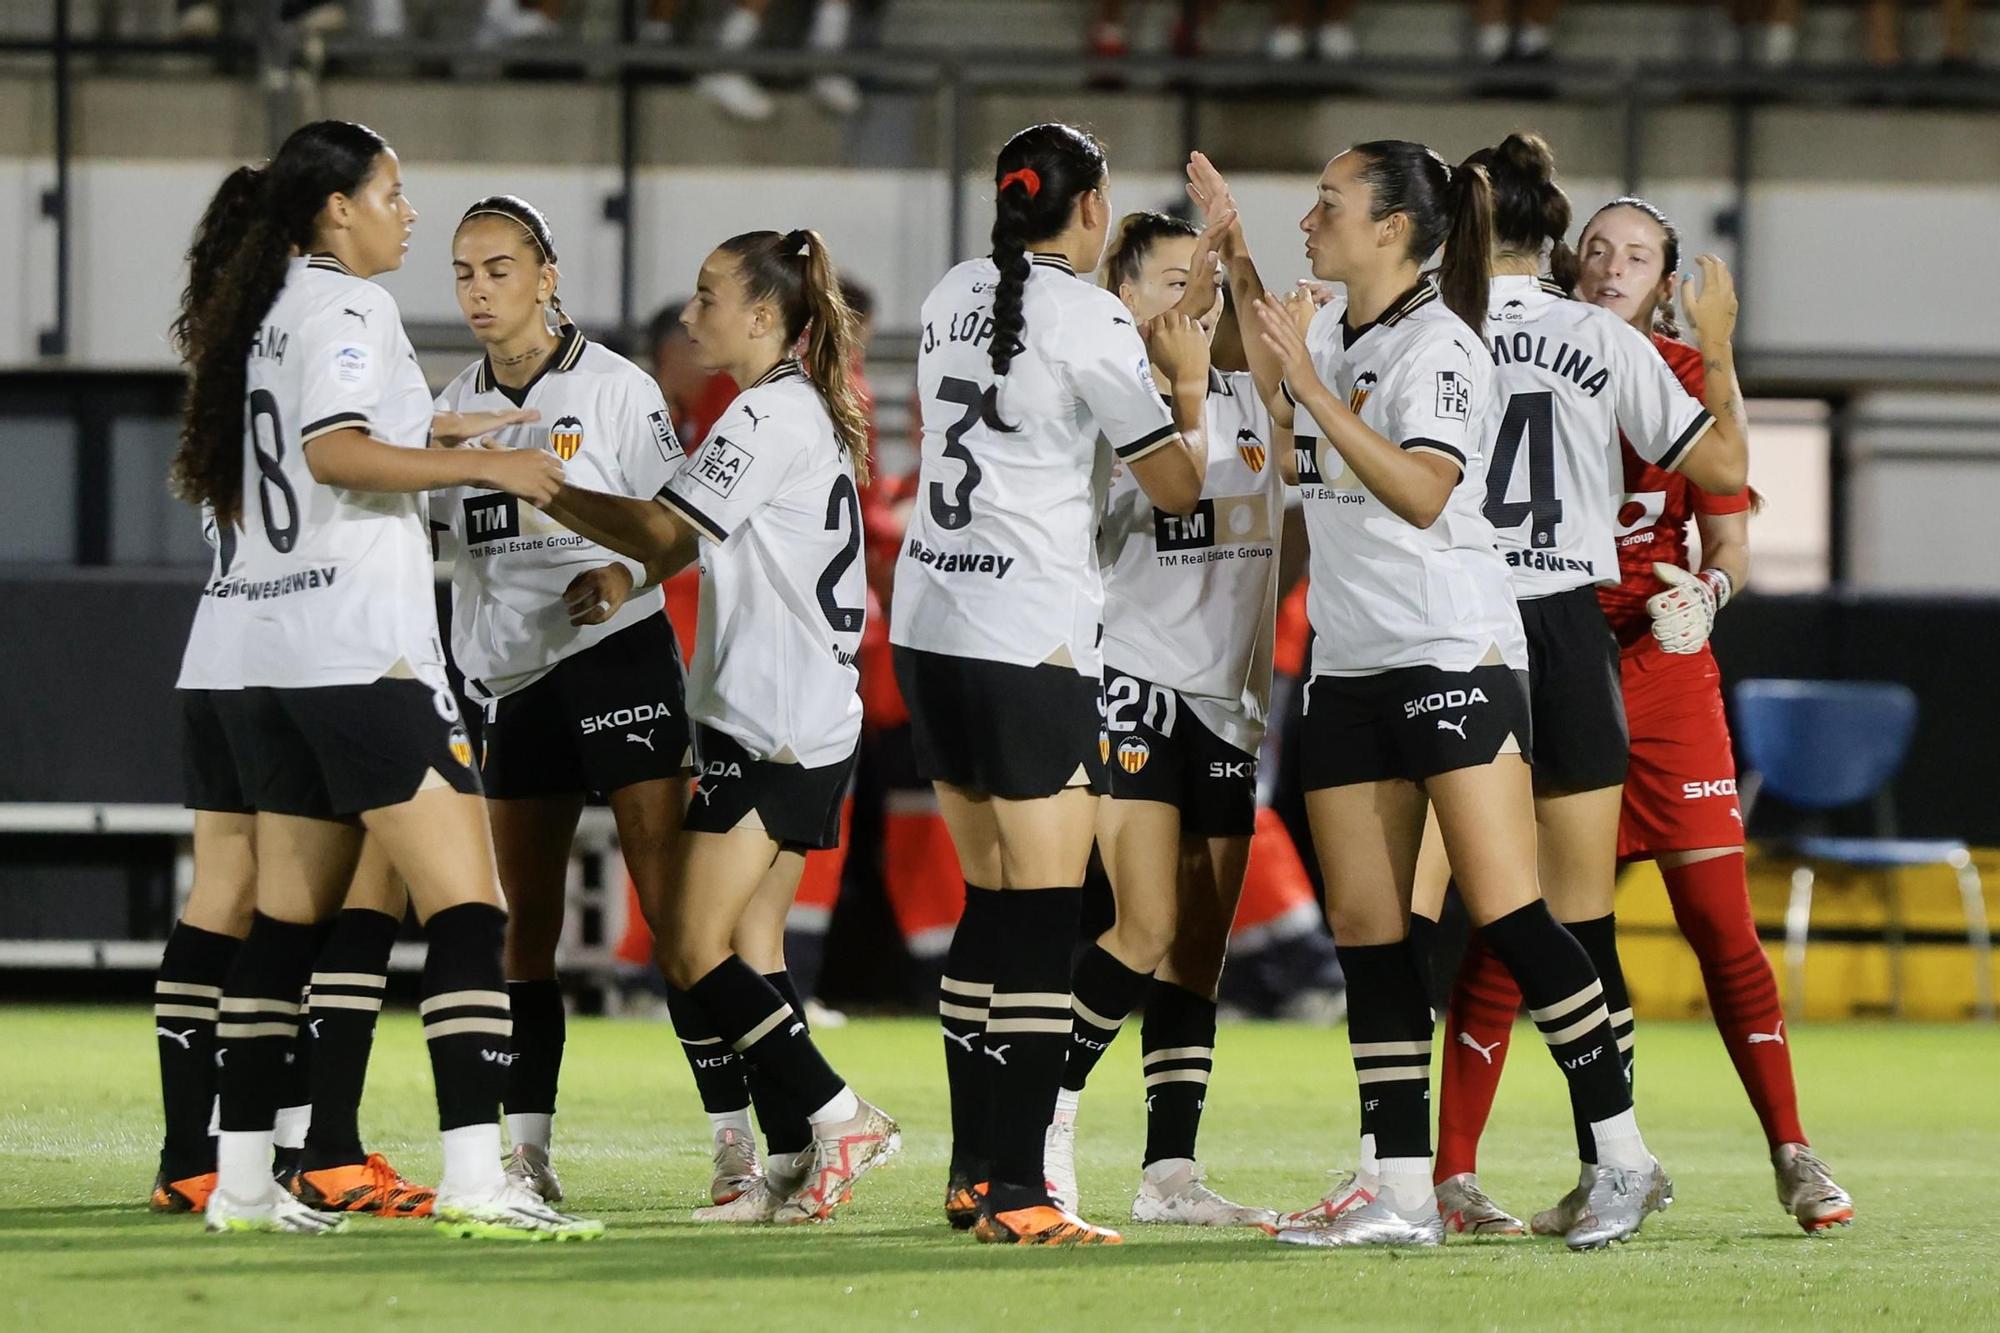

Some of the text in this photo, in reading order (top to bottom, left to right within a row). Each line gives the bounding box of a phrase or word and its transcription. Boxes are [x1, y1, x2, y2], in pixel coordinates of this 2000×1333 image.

[250, 325, 290, 367] RNA
[924, 321, 940, 354] J.
[1490, 331, 1609, 397] MOLINA
[930, 375, 983, 530] 3
[250, 388, 299, 554] 8
[699, 458, 733, 489] TEM
[1482, 391, 1563, 548] 4
[1337, 494, 1366, 506] roup
[472, 504, 508, 533] TM
[1164, 513, 1206, 541] TM
[470, 535, 584, 560] TM Real Estate Group
[816, 473, 865, 632] 2
[1622, 531, 1655, 546] Group
[1158, 556, 1178, 567] TM
[1181, 552, 1206, 565] Real
[1238, 547, 1273, 560] Group
[580, 702, 672, 735] SKODA
[1106, 676, 1177, 738] 20
[1403, 687, 1489, 719] SKODA
[696, 1053, 734, 1068] VCF
[1564, 1045, 1603, 1069] VCF
